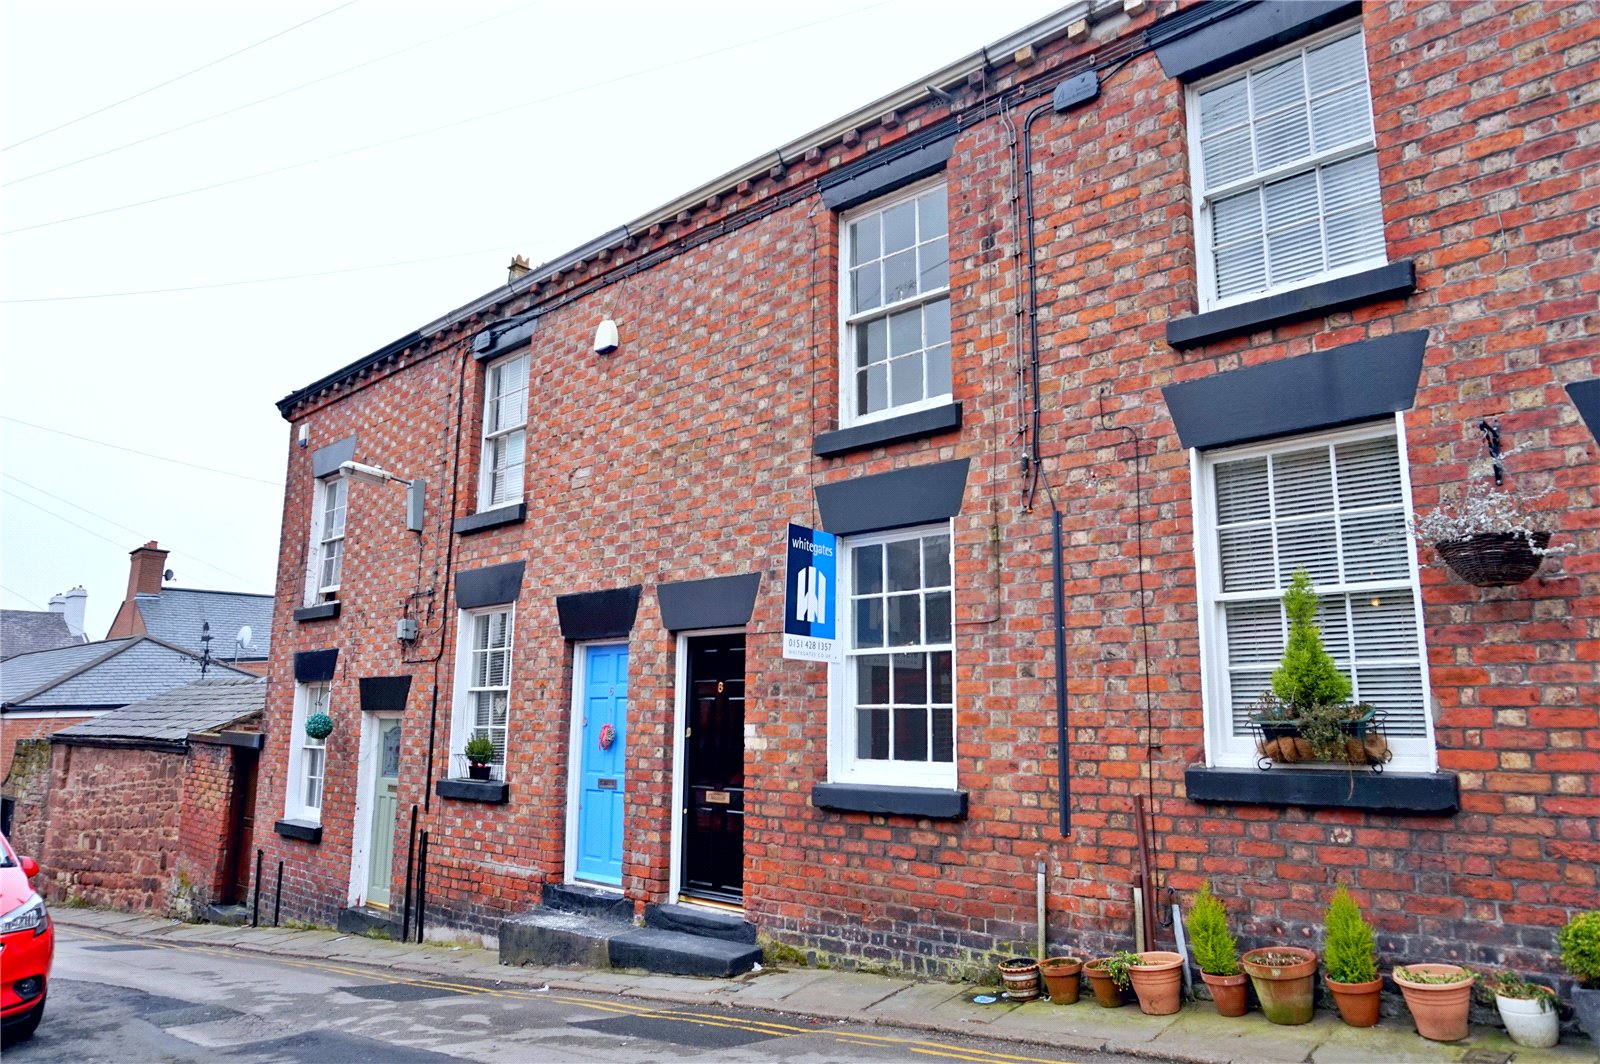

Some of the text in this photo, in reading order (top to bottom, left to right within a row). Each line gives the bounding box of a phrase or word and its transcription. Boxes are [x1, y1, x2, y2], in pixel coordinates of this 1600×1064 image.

[792, 537, 833, 557] whitegates
[788, 638, 832, 651] 0151 428 1357
